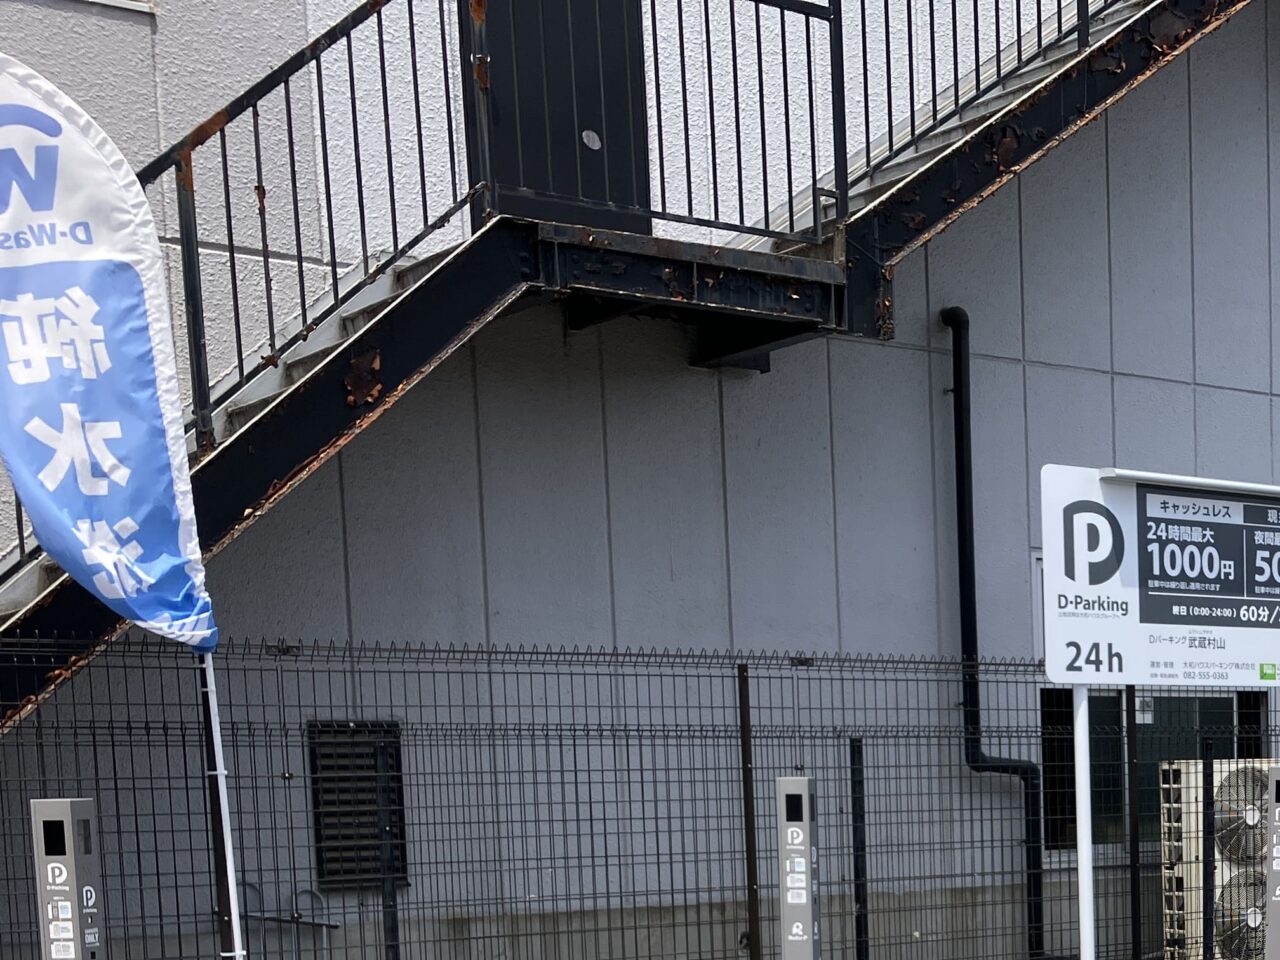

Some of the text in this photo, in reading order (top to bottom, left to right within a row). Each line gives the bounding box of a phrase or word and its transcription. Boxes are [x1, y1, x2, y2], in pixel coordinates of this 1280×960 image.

[1160, 500, 1231, 518] キャッシュレス
[1147, 522, 1214, 543] 24時間最大
[1147, 543, 1235, 580] 1000円
[1188, 636, 1226, 650] 武蔵村山
[1183, 671, 1229, 680] 082-555-0363
